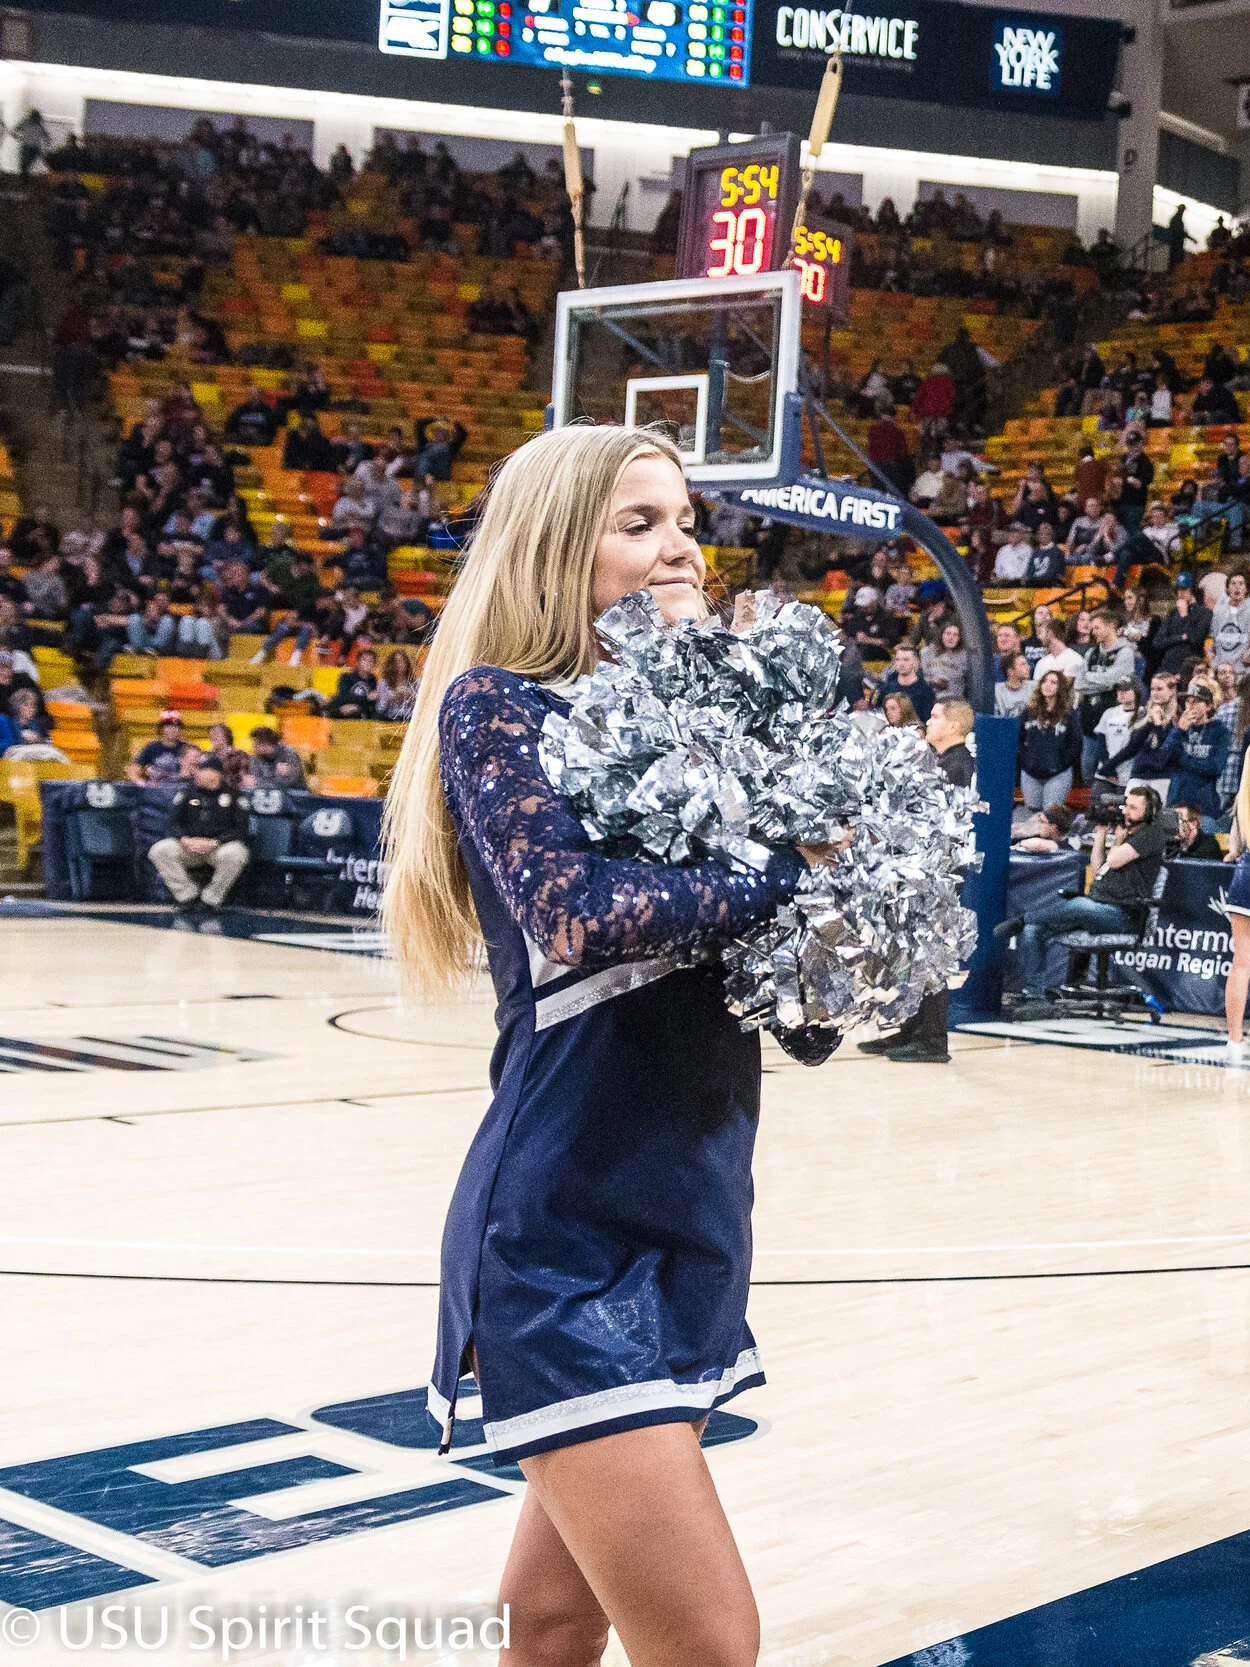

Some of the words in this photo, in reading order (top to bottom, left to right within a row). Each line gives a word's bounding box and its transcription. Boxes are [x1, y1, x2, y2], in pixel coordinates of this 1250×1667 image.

[776, 6, 919, 60] CONSERVICE
[1002, 27, 1055, 50] NEW
[995, 43, 1060, 73] YORK
[1001, 65, 1052, 90] LIFE
[721, 165, 779, 207] 5:54
[707, 207, 767, 278] 30
[794, 225, 842, 264] 5:54
[839, 495, 900, 530] FIRST
